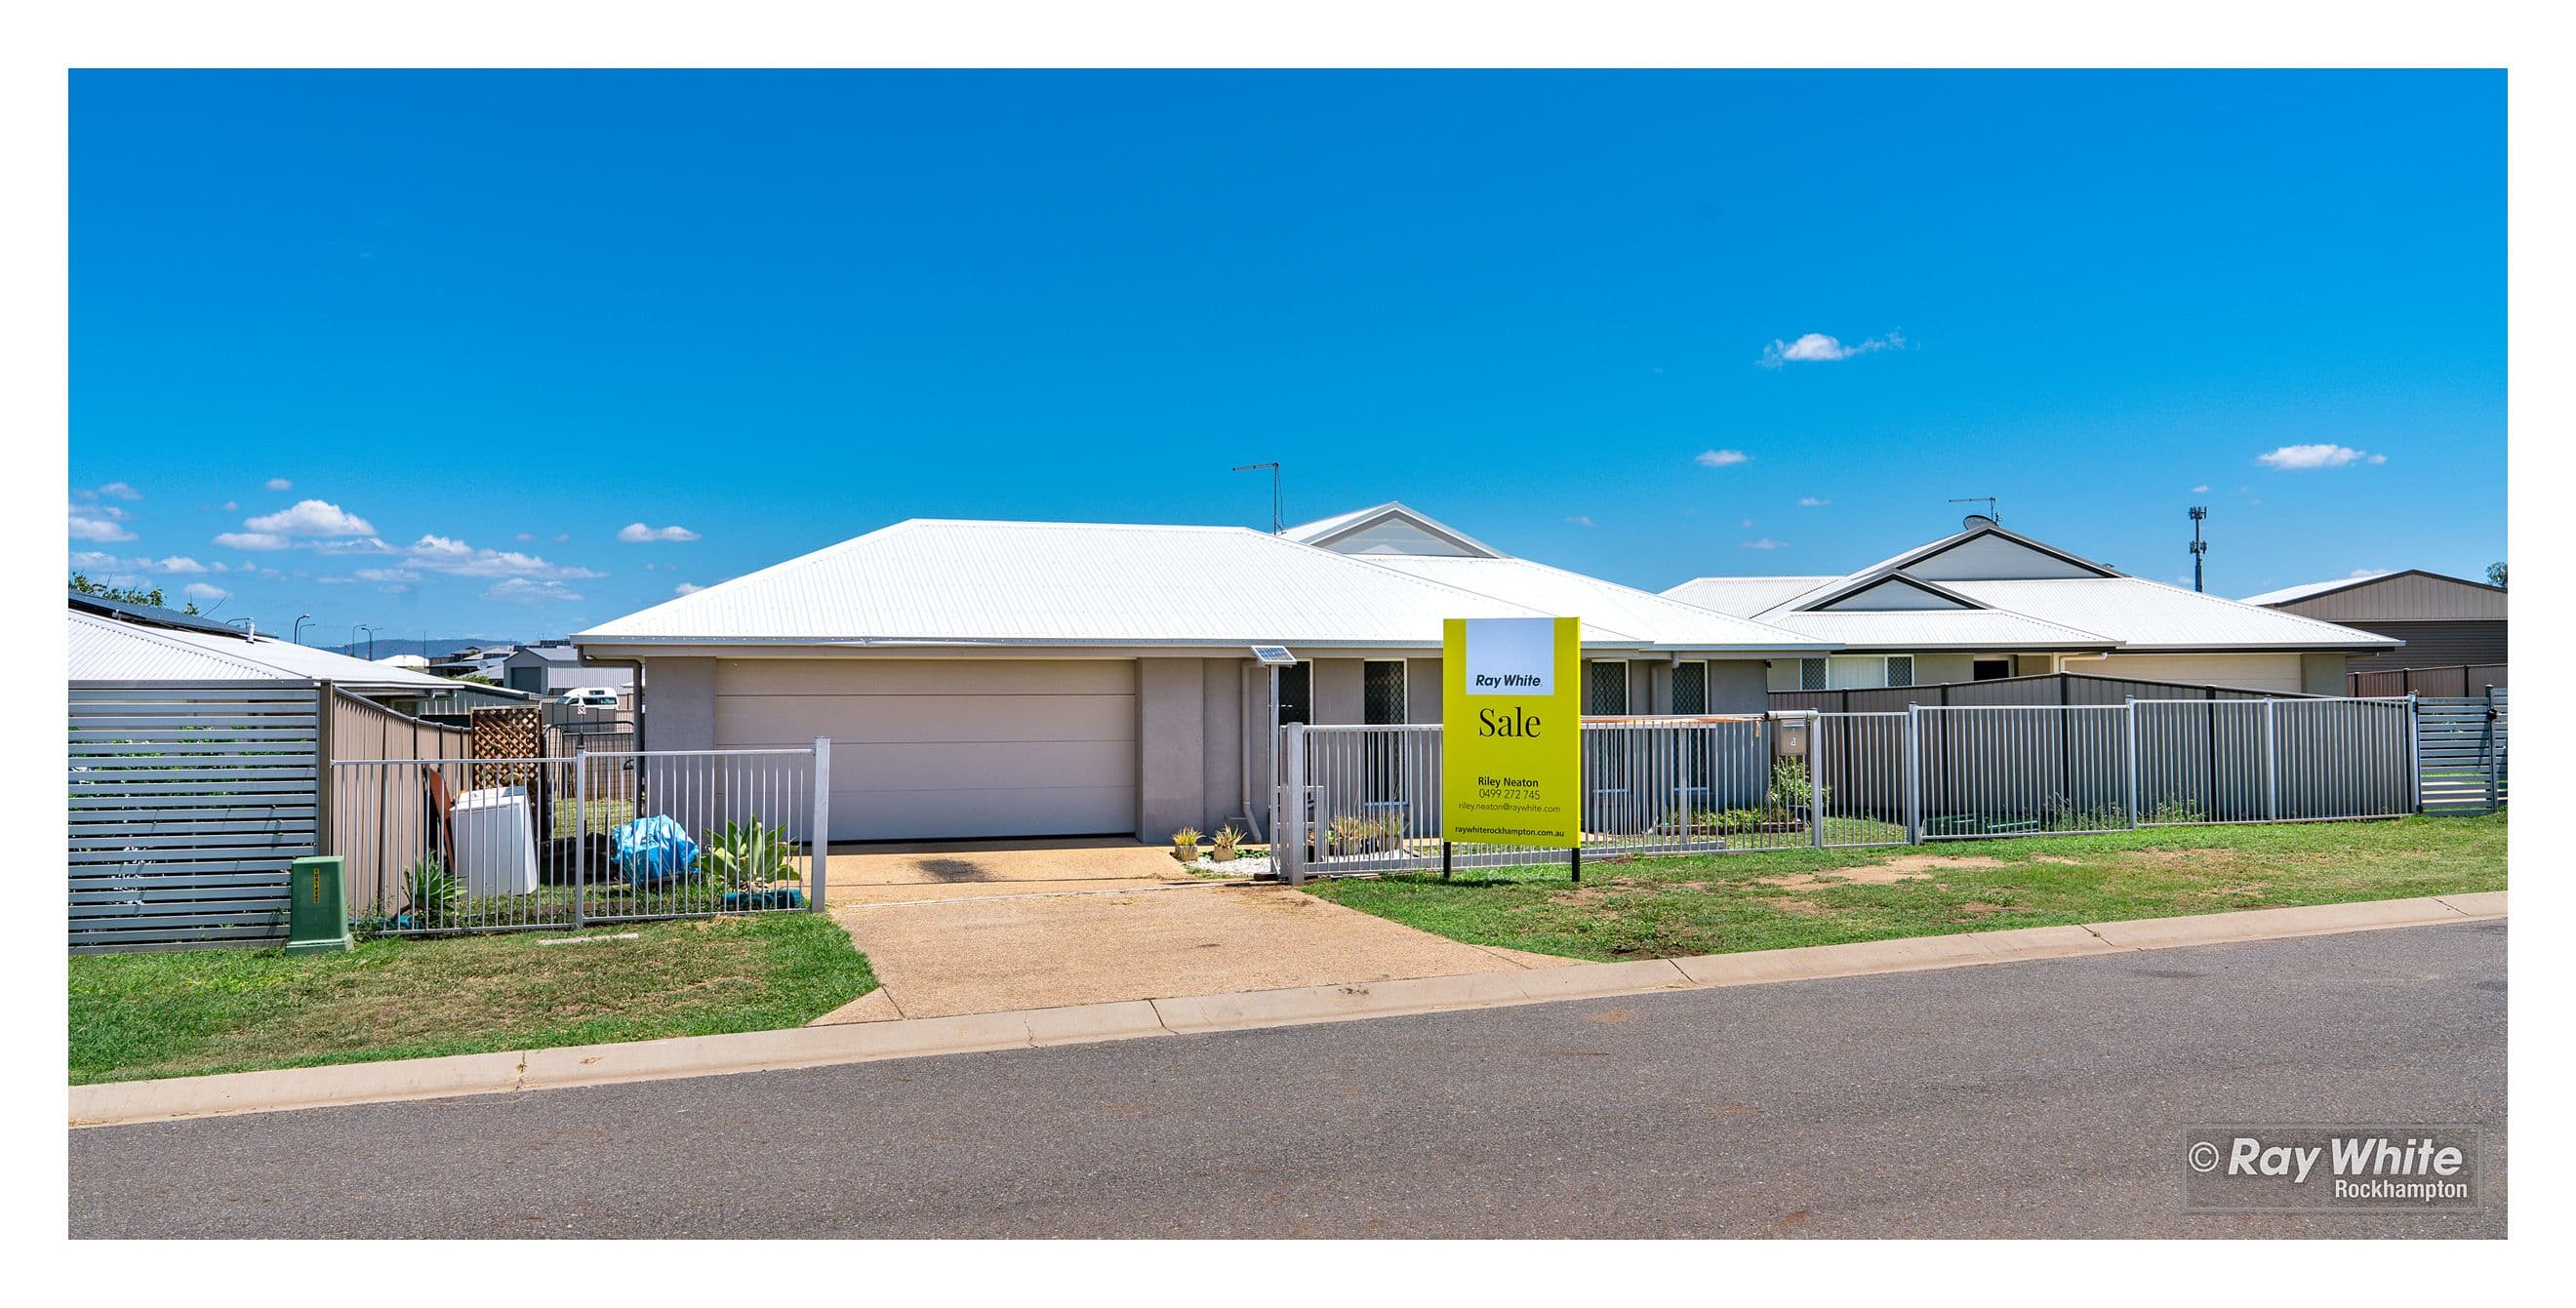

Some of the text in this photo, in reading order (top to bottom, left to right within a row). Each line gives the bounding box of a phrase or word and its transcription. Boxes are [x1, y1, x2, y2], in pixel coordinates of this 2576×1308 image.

[1475, 674, 1541, 688] Ray White
[1479, 706, 1542, 738] Sale
[1478, 776, 1539, 788] Riley Neaton
[1478, 788, 1541, 801] 0499 272 745
[1459, 801, 1561, 813] riley.neaton@raywhite.com
[1455, 826, 1565, 838] raywhiterockhampton.com.au
